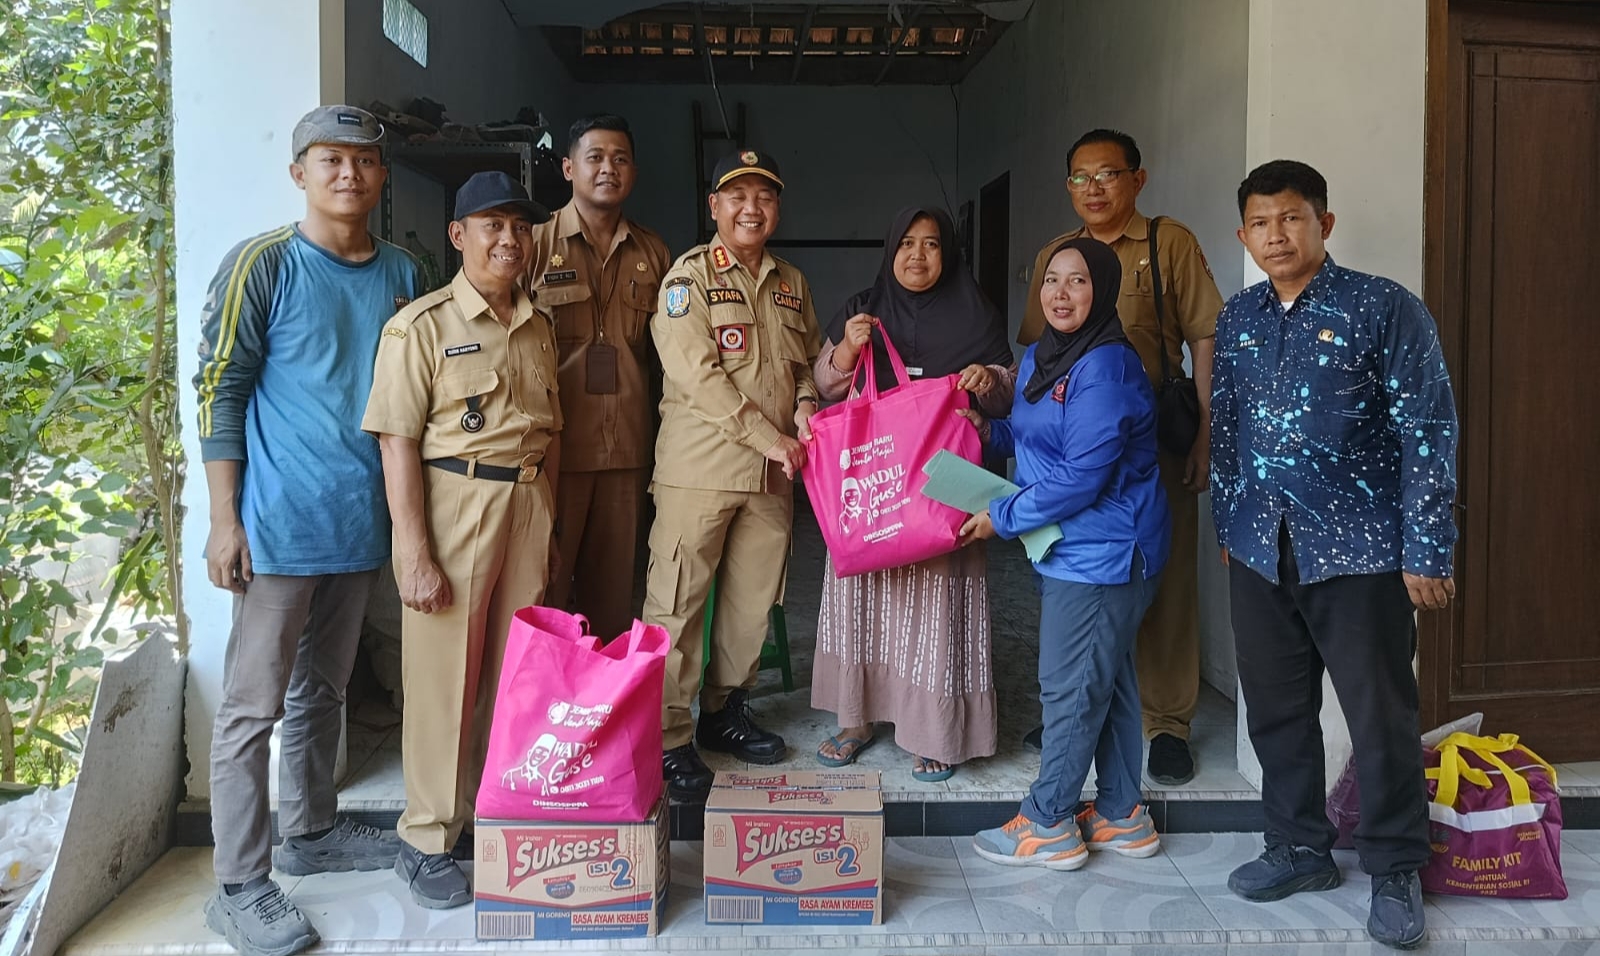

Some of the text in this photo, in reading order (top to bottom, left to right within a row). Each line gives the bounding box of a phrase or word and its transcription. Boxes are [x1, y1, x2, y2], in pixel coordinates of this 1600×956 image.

[710, 290, 743, 302] SYAFA
[859, 463, 906, 491] WADUL
[742, 823, 842, 862] Sukses's
[513, 836, 616, 878] Sukses's
[816, 846, 858, 874] ISI 2
[1451, 852, 1522, 872] FAMILY KIT
[589, 857, 632, 887] ISI 2
[1474, 872, 1507, 882] BANTUAN
[1446, 878, 1497, 890] KEMENTERIAN
[1498, 880, 1522, 889] SOSIAL
[800, 899, 819, 909] RASA
[820, 899, 841, 909] AYAM
[842, 899, 874, 909] KREMEES
[573, 914, 592, 924] RASA
[594, 913, 615, 924] AYAM
[616, 912, 649, 923] KREMEES
